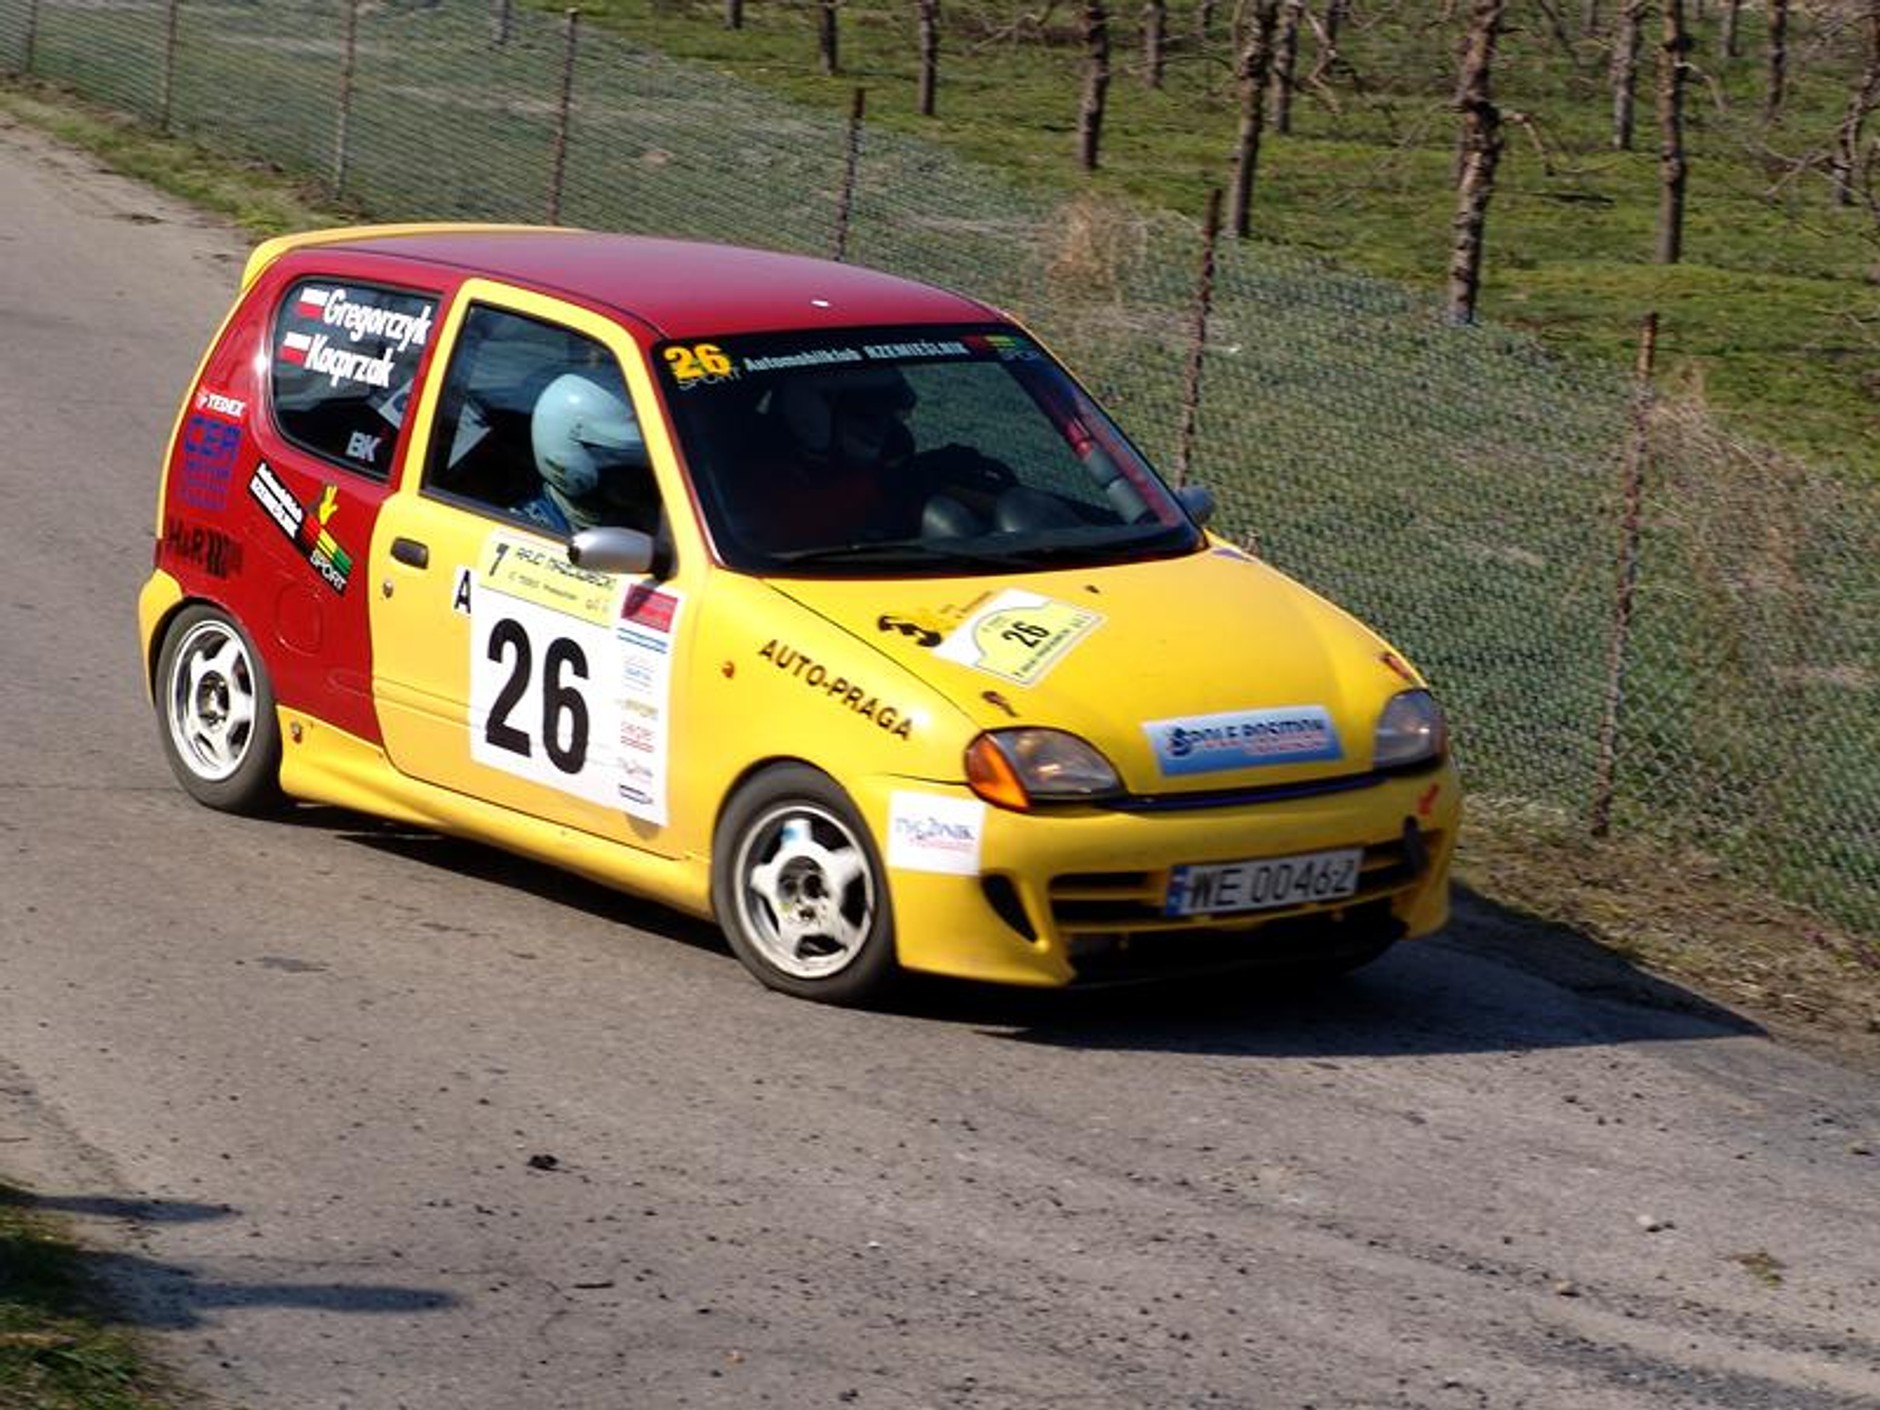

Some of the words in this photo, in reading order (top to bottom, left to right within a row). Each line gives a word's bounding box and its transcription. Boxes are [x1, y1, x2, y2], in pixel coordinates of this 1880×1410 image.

[323, 289, 432, 352] Gregorczyk
[664, 343, 732, 380] 26
[345, 431, 382, 462] BK
[453, 569, 472, 614] A
[1001, 621, 1050, 649] 26
[485, 617, 590, 775] 26
[757, 638, 914, 741] AUTO-PRAGA
